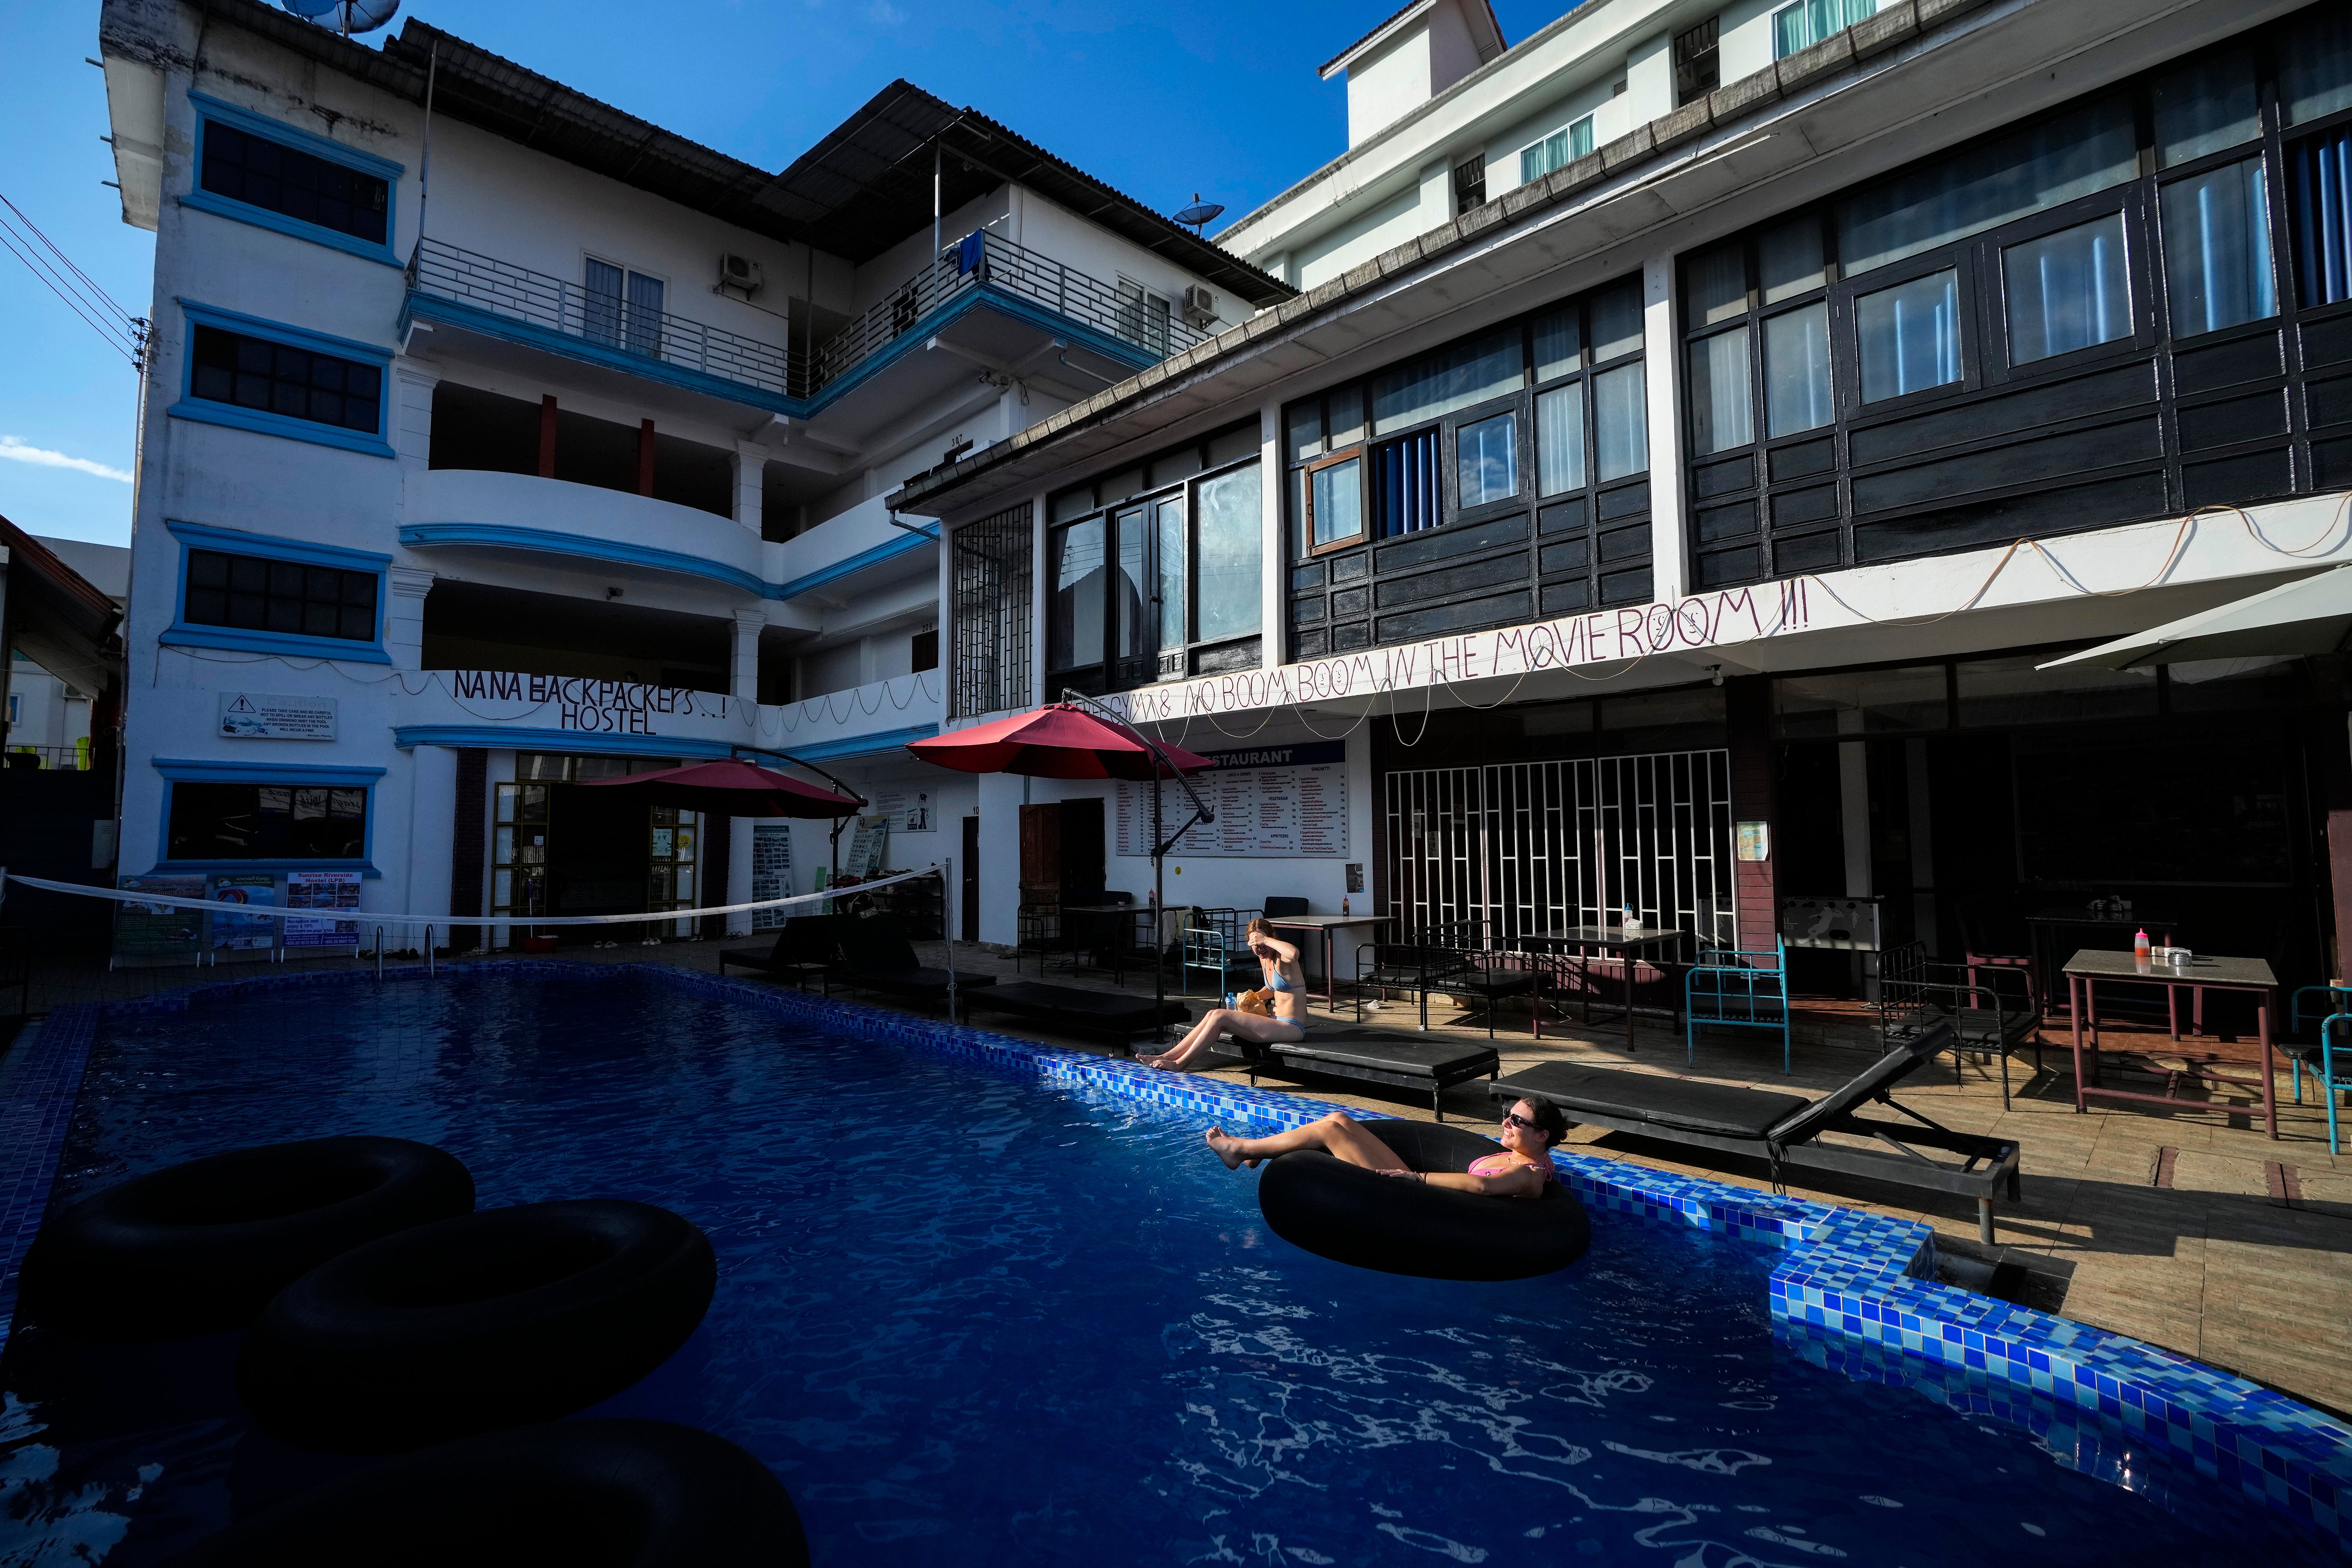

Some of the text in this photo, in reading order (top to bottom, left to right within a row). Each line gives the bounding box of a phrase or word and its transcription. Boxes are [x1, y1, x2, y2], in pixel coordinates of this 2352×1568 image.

[952, 434, 962, 446] 307
[1110, 693, 1147, 724] GYM
[1160, 689, 1171, 717] &
[1184, 681, 1216, 714] NO
[1222, 670, 1290, 711] BOOM
[1298, 654, 1377, 702] BOOM
[1385, 646, 1416, 689] IN
[1424, 635, 1479, 684] THE
[1617, 587, 1762, 659] ROOM
[1781, 579, 1808, 631] !!!
[455, 670, 522, 701] NANA
[561, 703, 657, 735] HOSTEL
[1203, 750, 1293, 767] STAURANT
